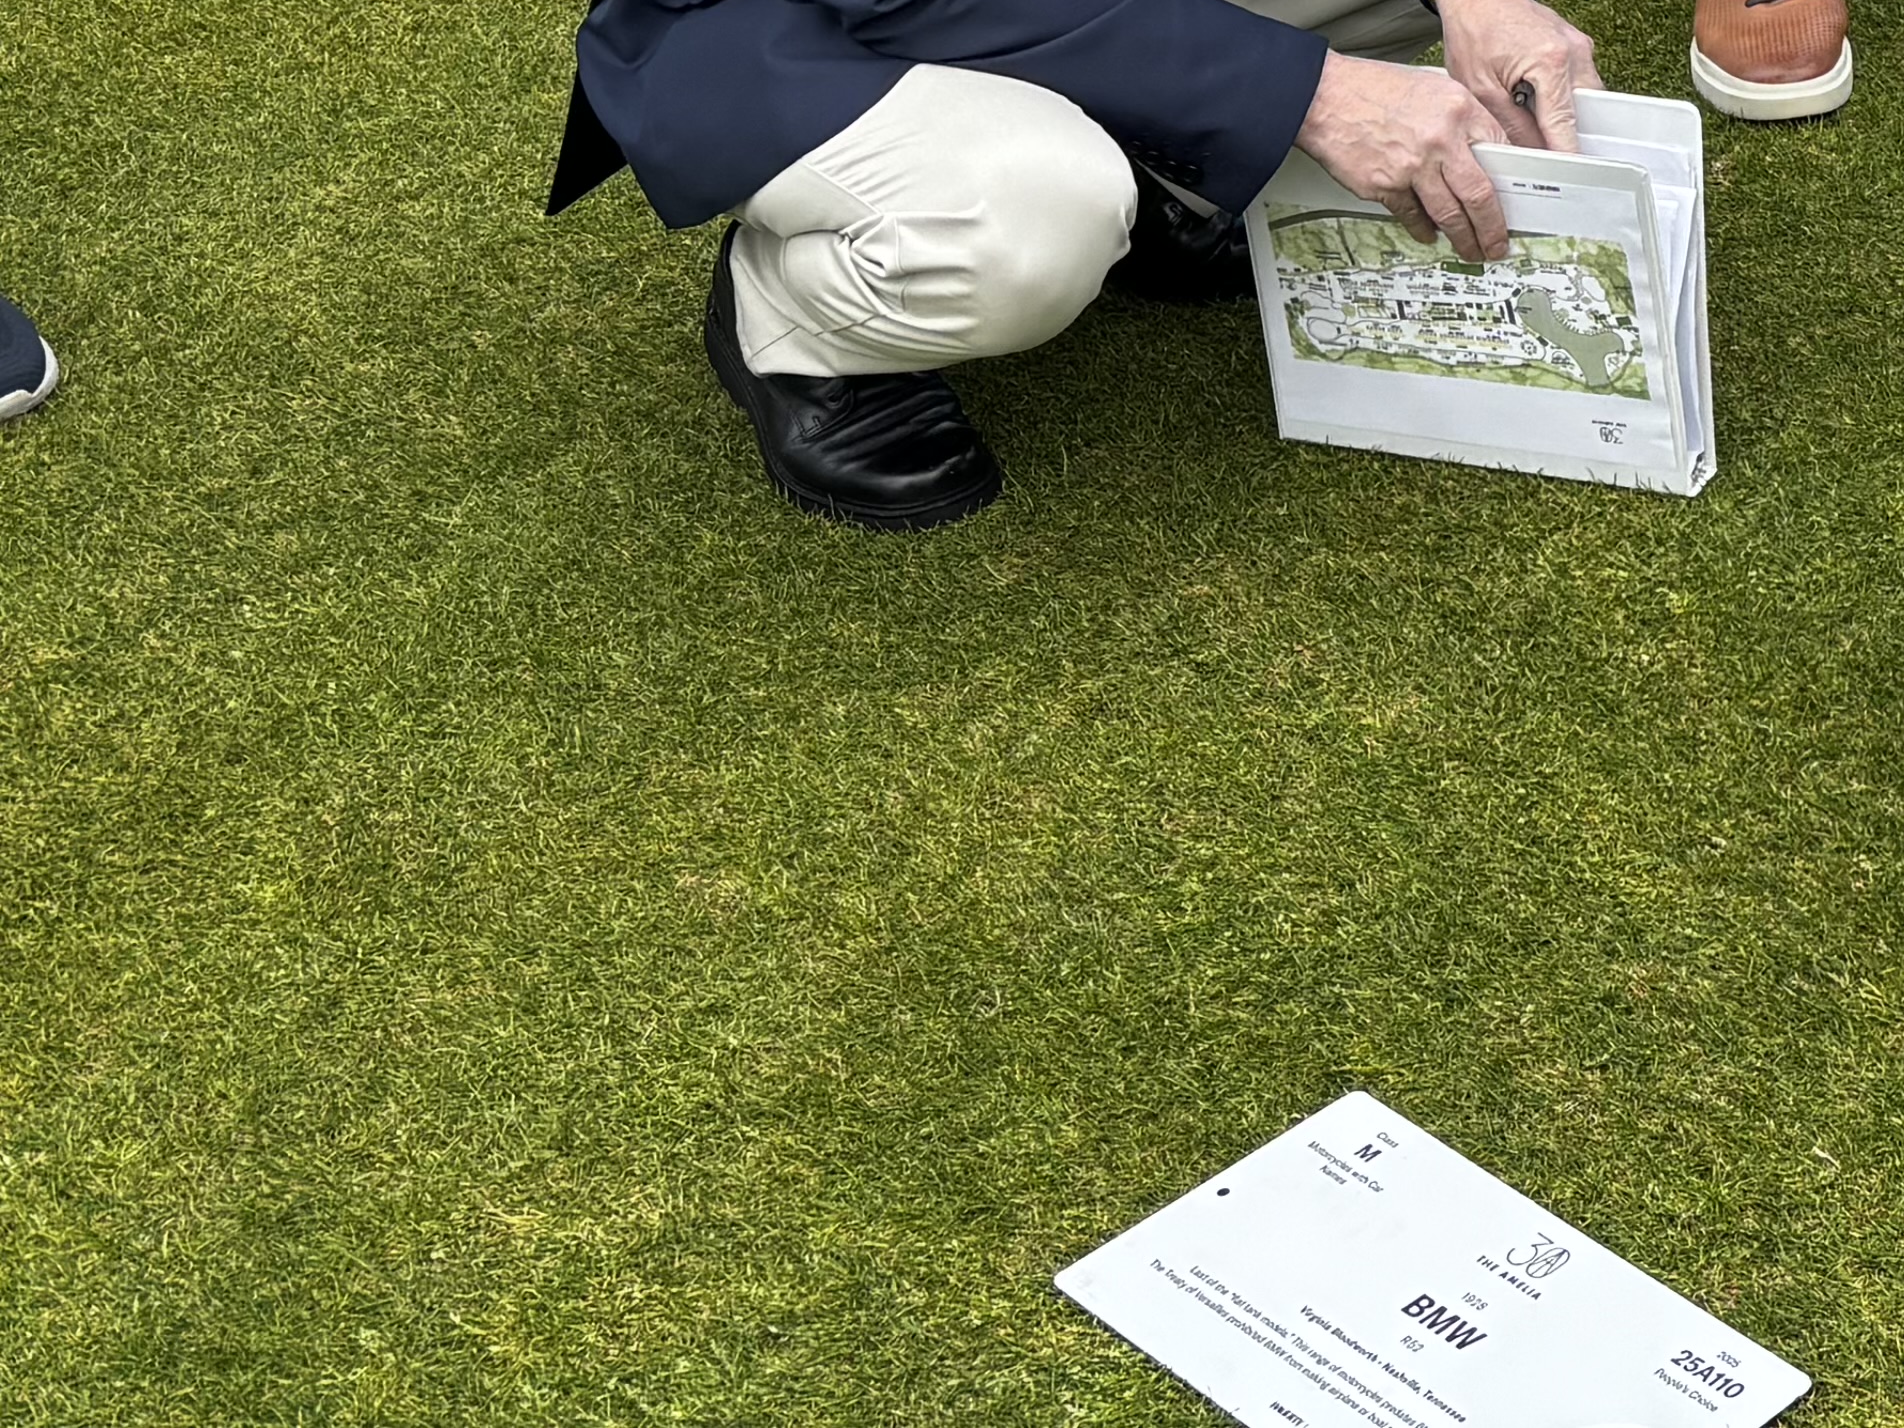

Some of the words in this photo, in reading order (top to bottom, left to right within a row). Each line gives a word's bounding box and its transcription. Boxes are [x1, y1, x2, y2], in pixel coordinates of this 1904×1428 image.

[1354, 1144, 1382, 1162] M
[1477, 1255, 1499, 1271] THE
[1499, 1272, 1541, 1300] AMELIA
[1401, 1294, 1488, 1350] BMW
[1670, 1350, 1745, 1398] 25A110
